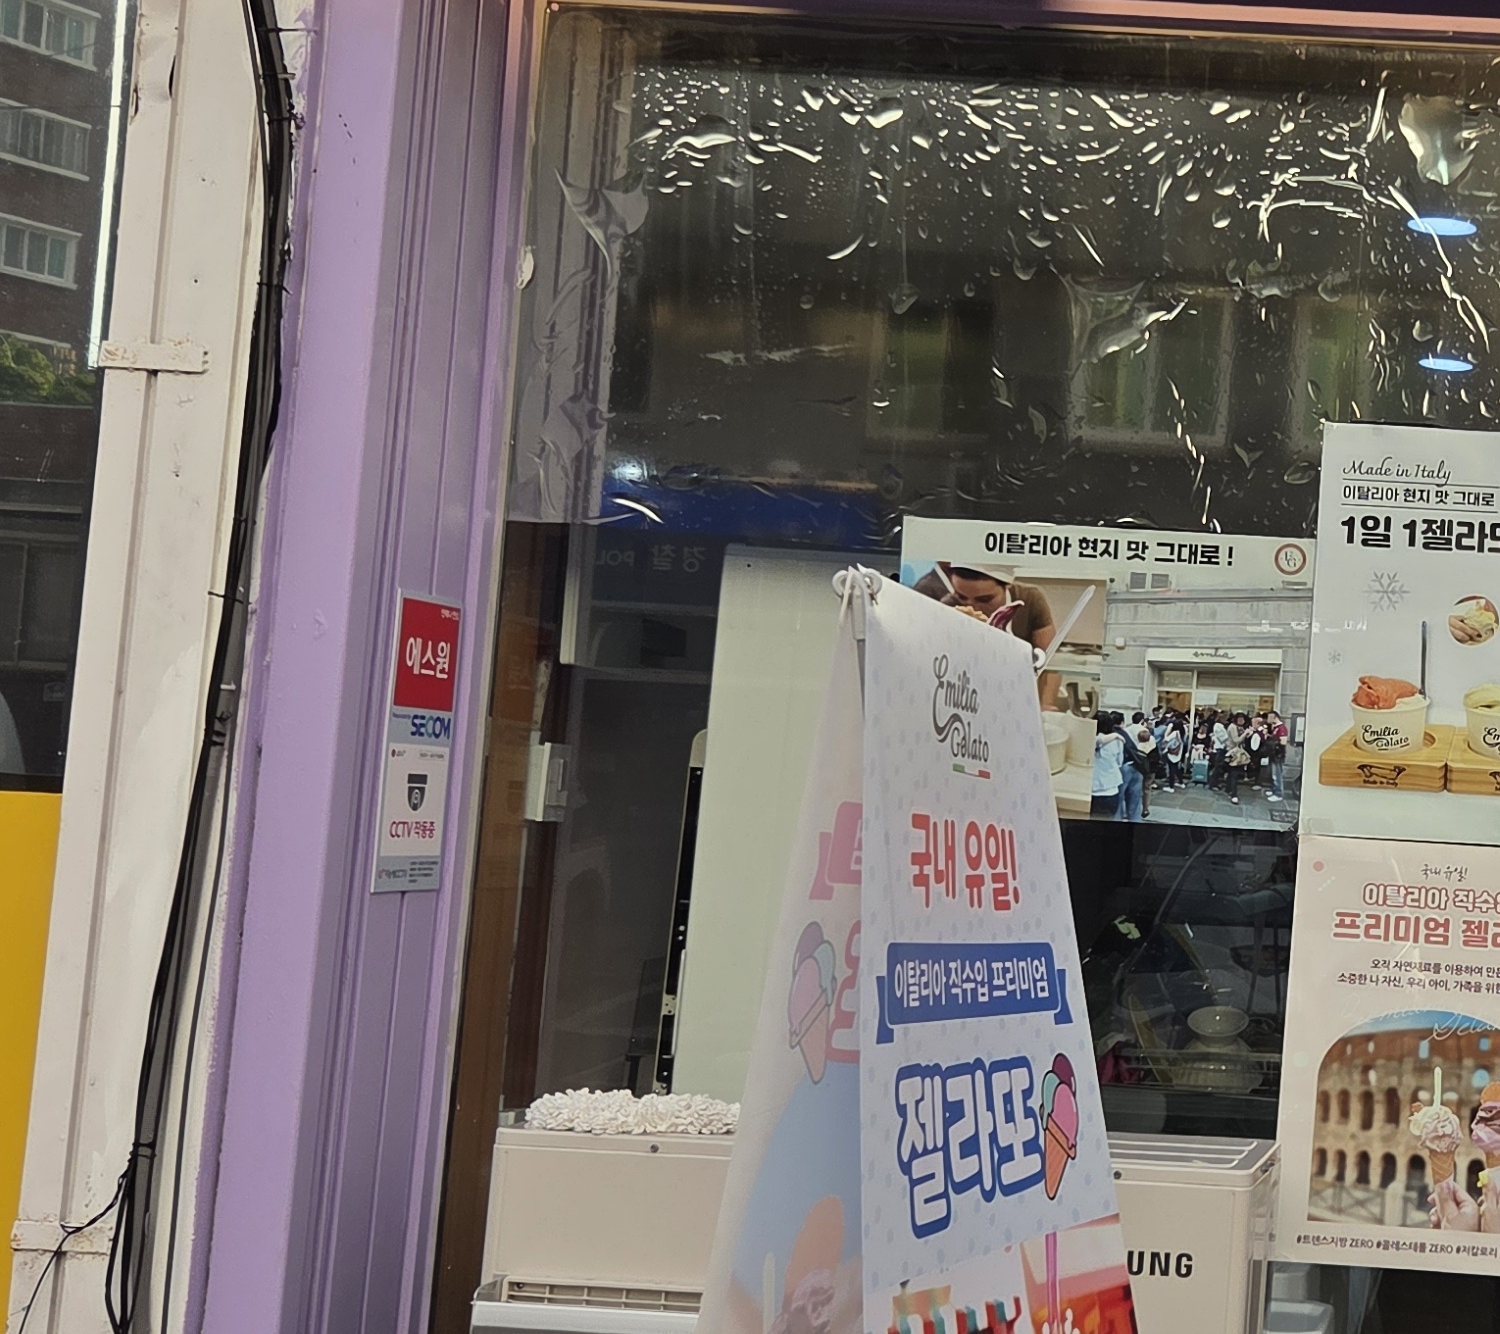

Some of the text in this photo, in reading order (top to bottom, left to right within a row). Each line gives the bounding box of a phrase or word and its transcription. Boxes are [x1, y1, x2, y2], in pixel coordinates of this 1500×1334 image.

[1342, 456, 1452, 488] Made in Italy
[1343, 485, 1495, 507] 이탈리아 현지 맛 그대로
[1341, 515, 1392, 549] 1일
[984, 532, 1072, 558] 이탈리아
[1077, 536, 1119, 560] 현지
[1126, 539, 1149, 562] 맛
[1154, 541, 1221, 566] 그대로
[405, 636, 451, 680] 에스원
[932, 653, 981, 727] Emilia
[410, 714, 452, 740] SECOM
[951, 717, 990, 763] Gelato
[1362, 724, 1400, 742] Emilia
[389, 820, 414, 839] CCTV
[909, 814, 1020, 912] 국내 유일!
[1363, 882, 1450, 911] 이탈리아
[1333, 911, 1451, 946] 프리미엄
[894, 956, 1050, 1008] 이탈리아 직수입 프리미엄
[1337, 972, 1367, 986] 소중한
[1369, 974, 1380, 986] 나
[1406, 977, 1426, 990] 우리
[1370, 959, 1391, 972] 오직
[1444, 963, 1484, 978] 이용하여
[896, 1056, 1045, 1238] 젤라또
[1349, 1238, 1375, 1249] ZERO
[1429, 1243, 1454, 1254] ZERO
